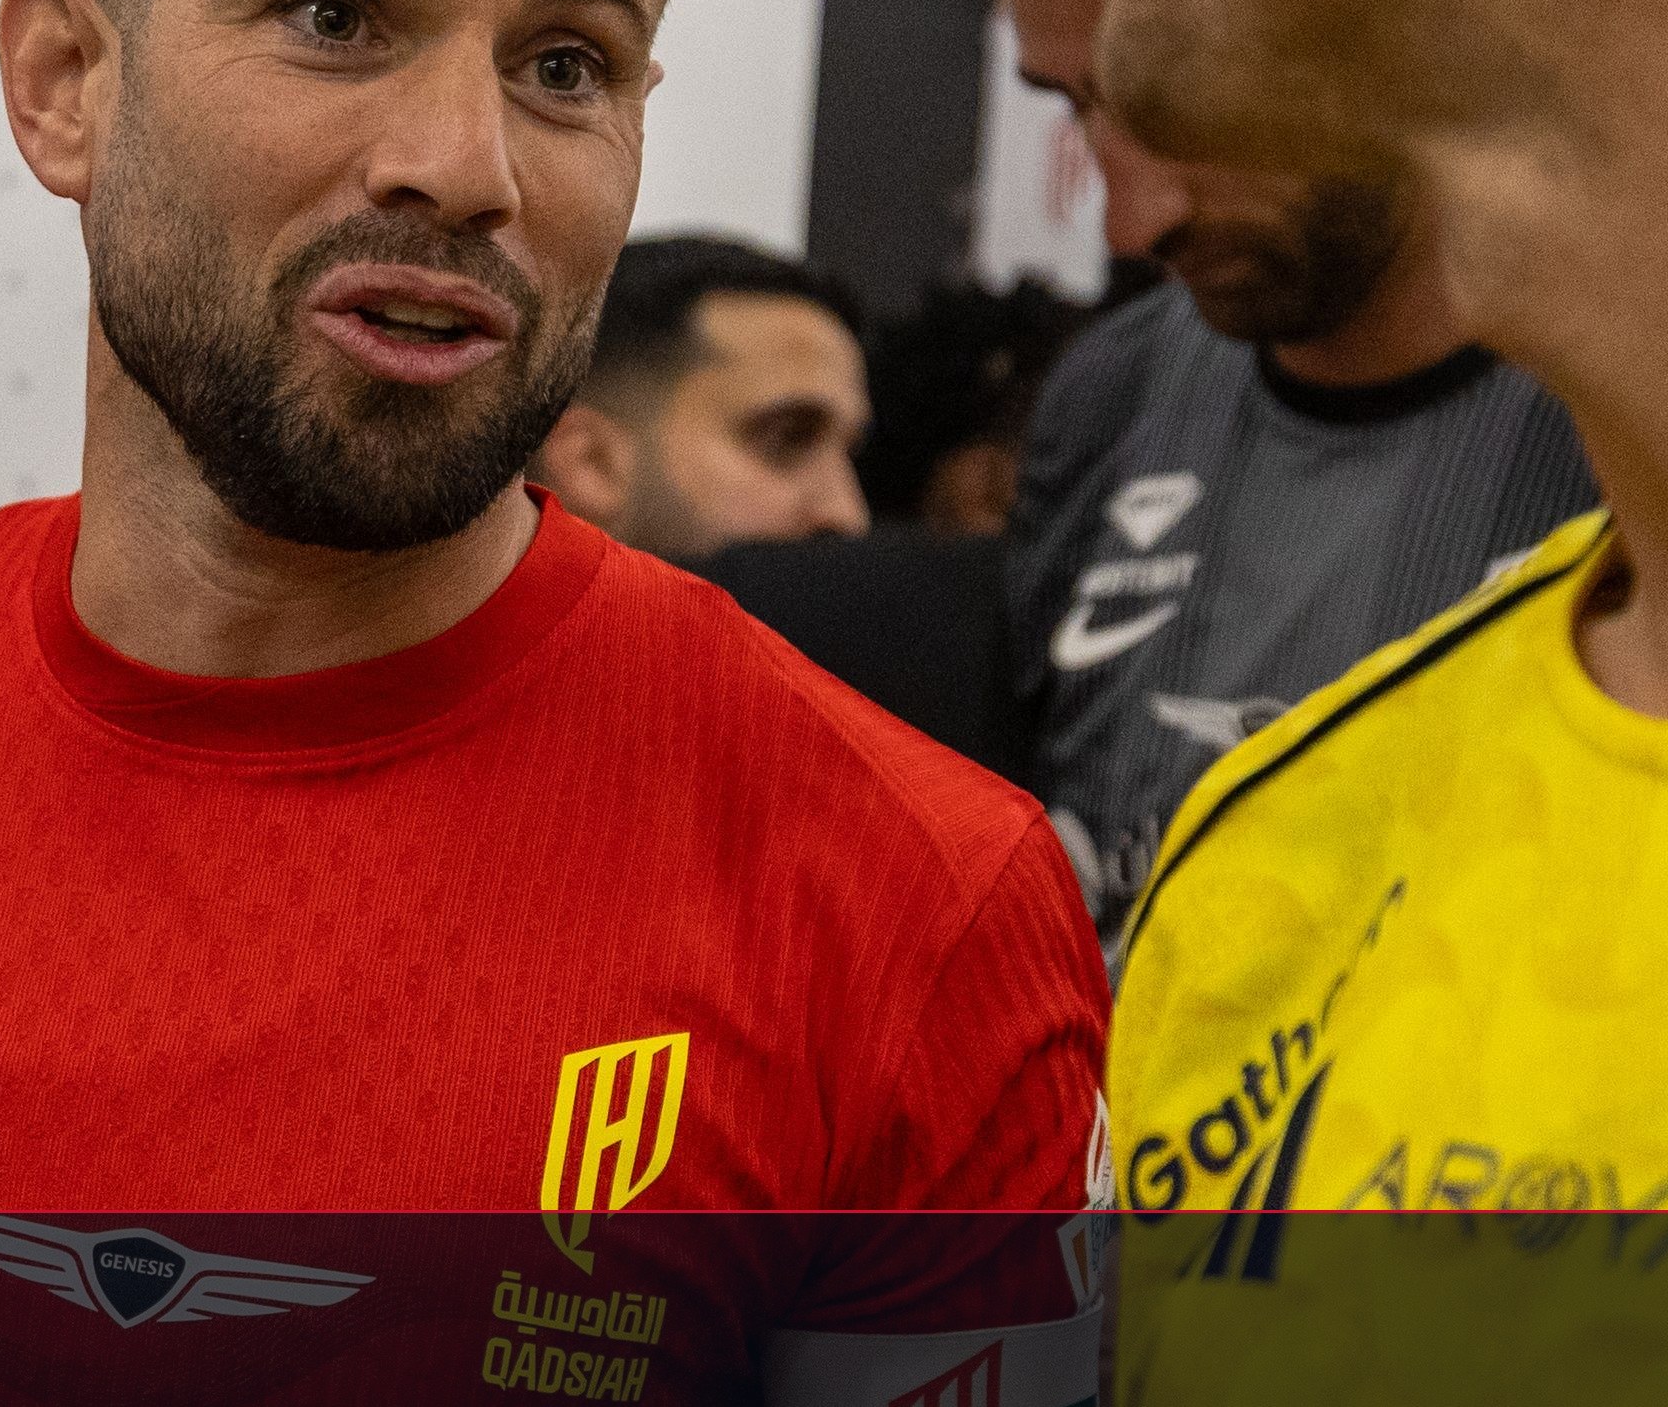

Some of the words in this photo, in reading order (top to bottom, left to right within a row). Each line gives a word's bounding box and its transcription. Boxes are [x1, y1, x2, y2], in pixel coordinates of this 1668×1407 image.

[100, 1252, 176, 1279] GENESIS
[492, 1269, 667, 1345] القادسية
[482, 1336, 650, 1403] QADSIAH
